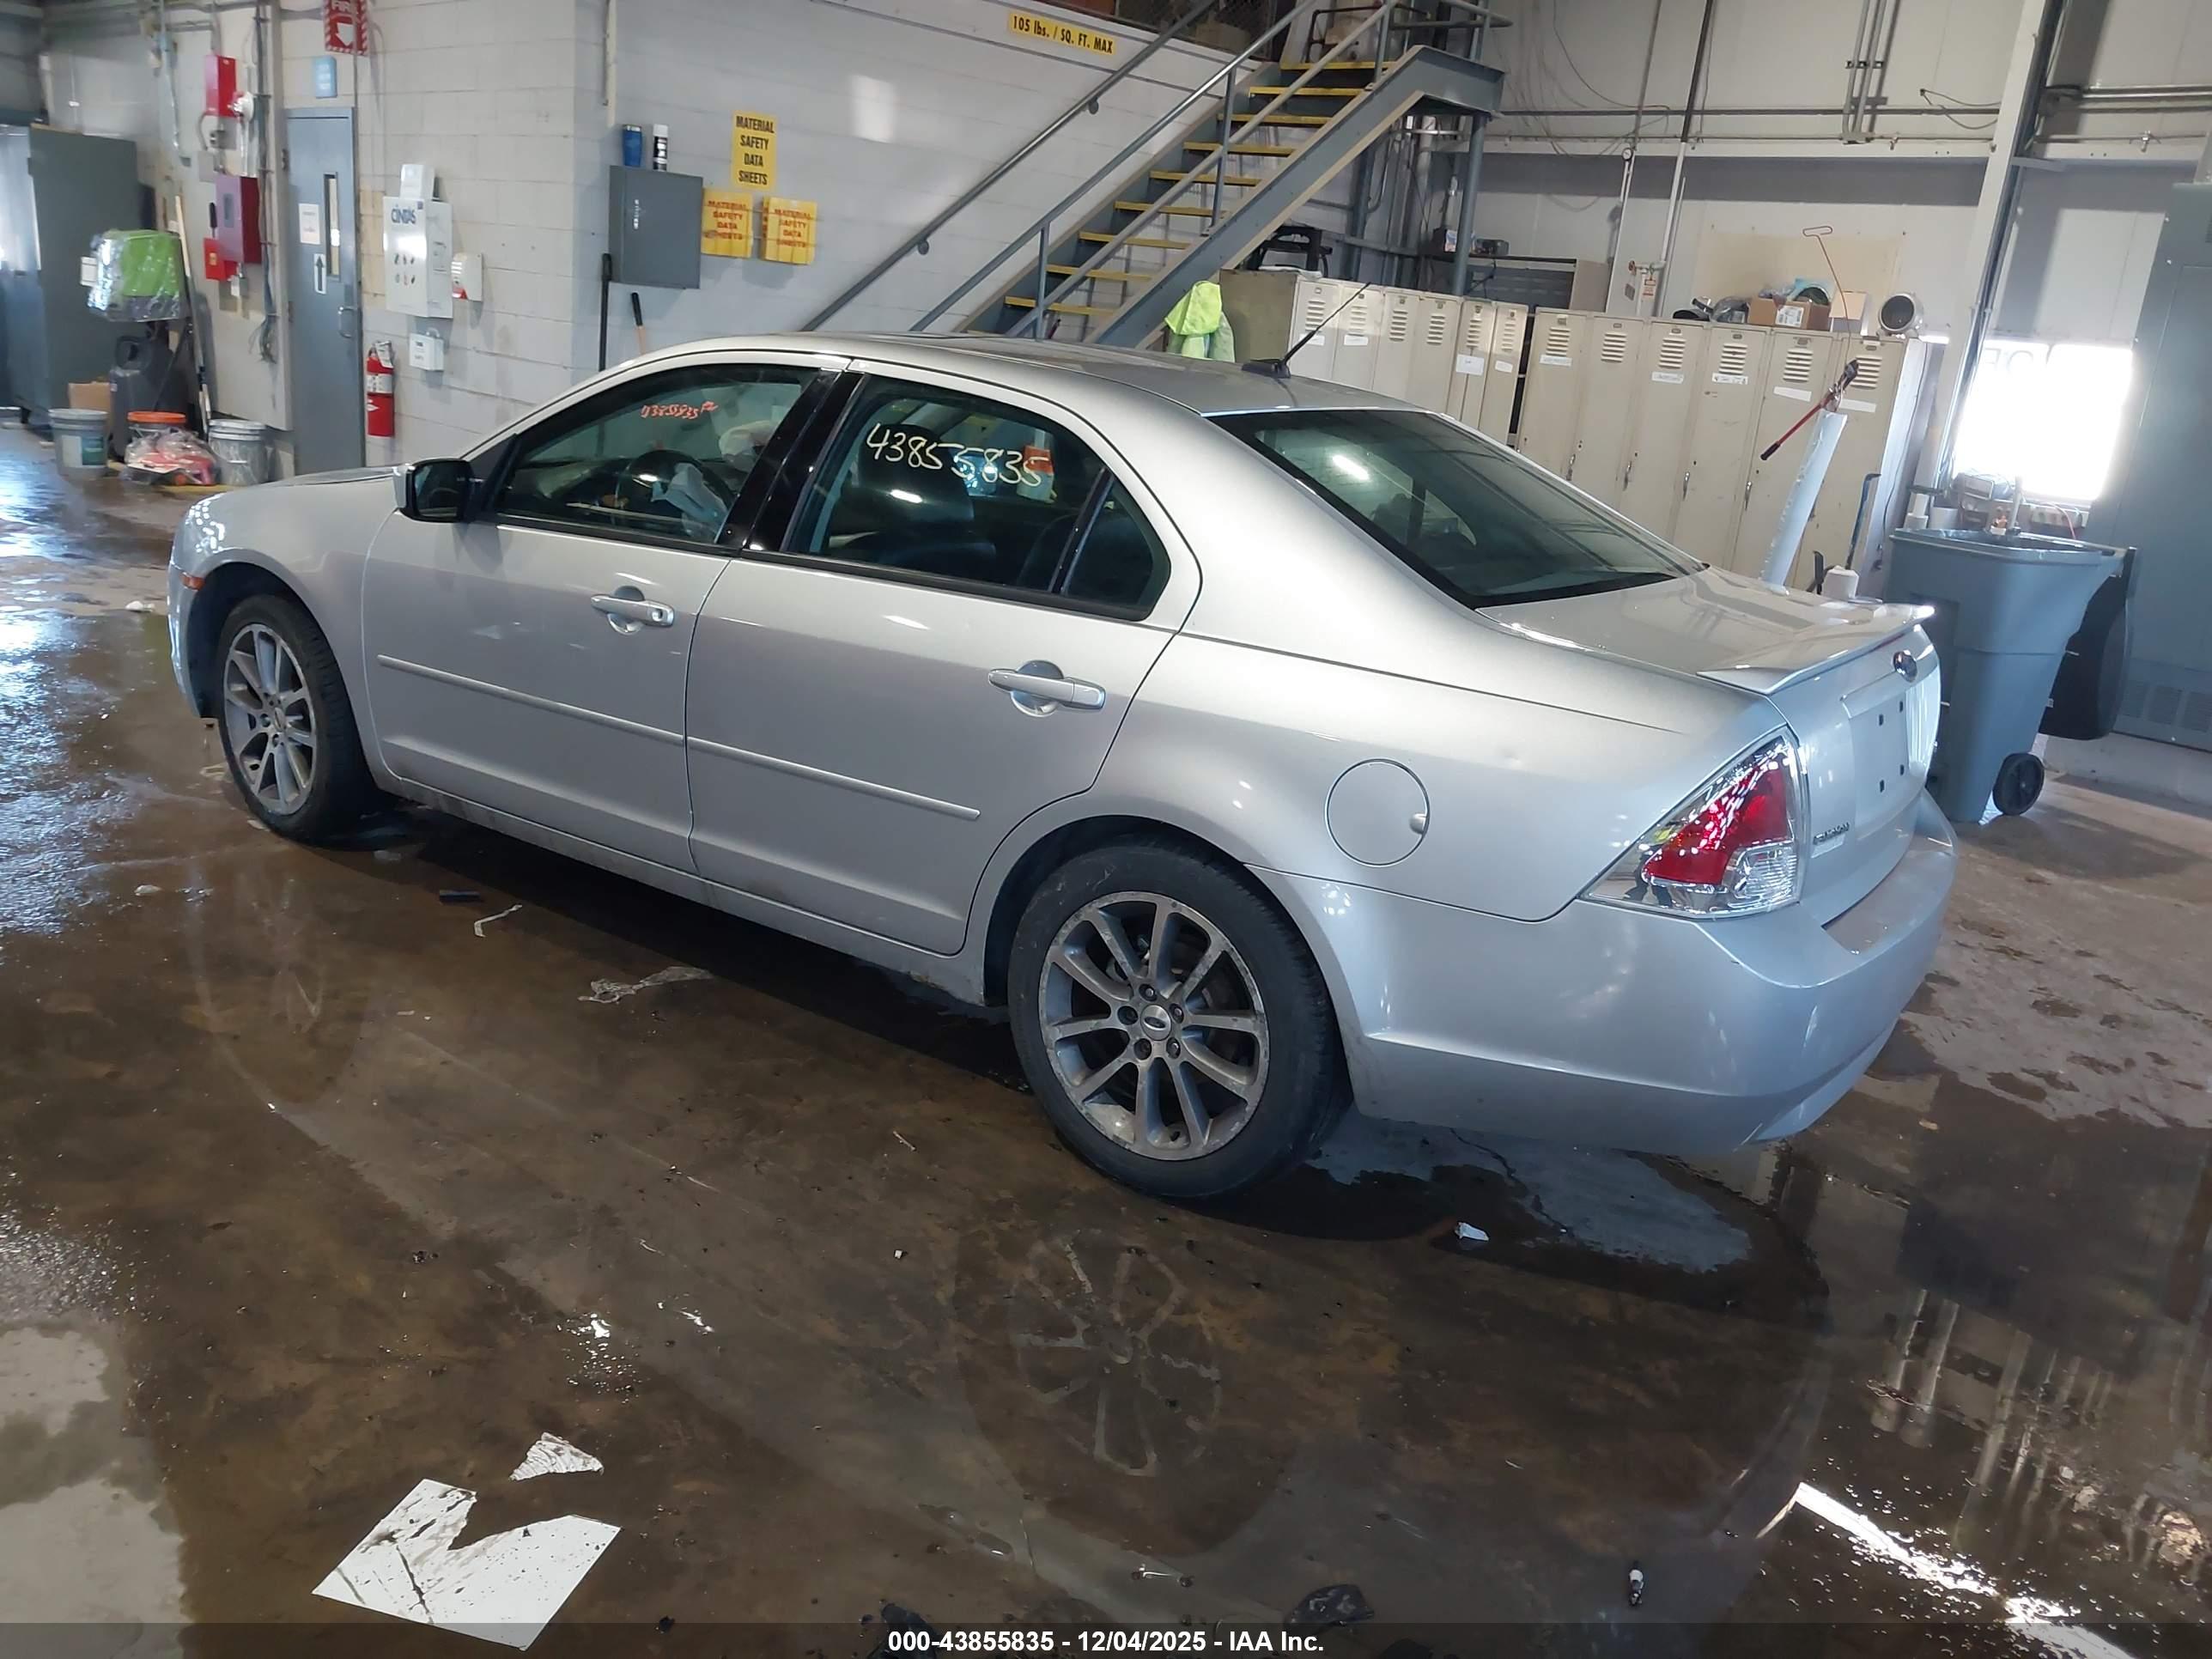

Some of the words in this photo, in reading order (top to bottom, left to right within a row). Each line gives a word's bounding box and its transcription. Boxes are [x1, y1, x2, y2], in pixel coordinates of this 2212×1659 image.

[1013, 15, 1030, 32] 105
[1034, 20, 1049, 38] lbs.
[1053, 26, 1059, 40] /
[1060, 28, 1074, 44] SQ.
[1079, 33, 1091, 49] FT.
[1093, 37, 1113, 54] MAX
[736, 115, 775, 134] MATERIAL
[740, 134, 769, 150] SAFETY
[744, 153, 763, 167] DATA
[738, 170, 768, 185] SHEETS
[717, 221, 738, 229] DATA
[866, 422, 1050, 487] 43855835
